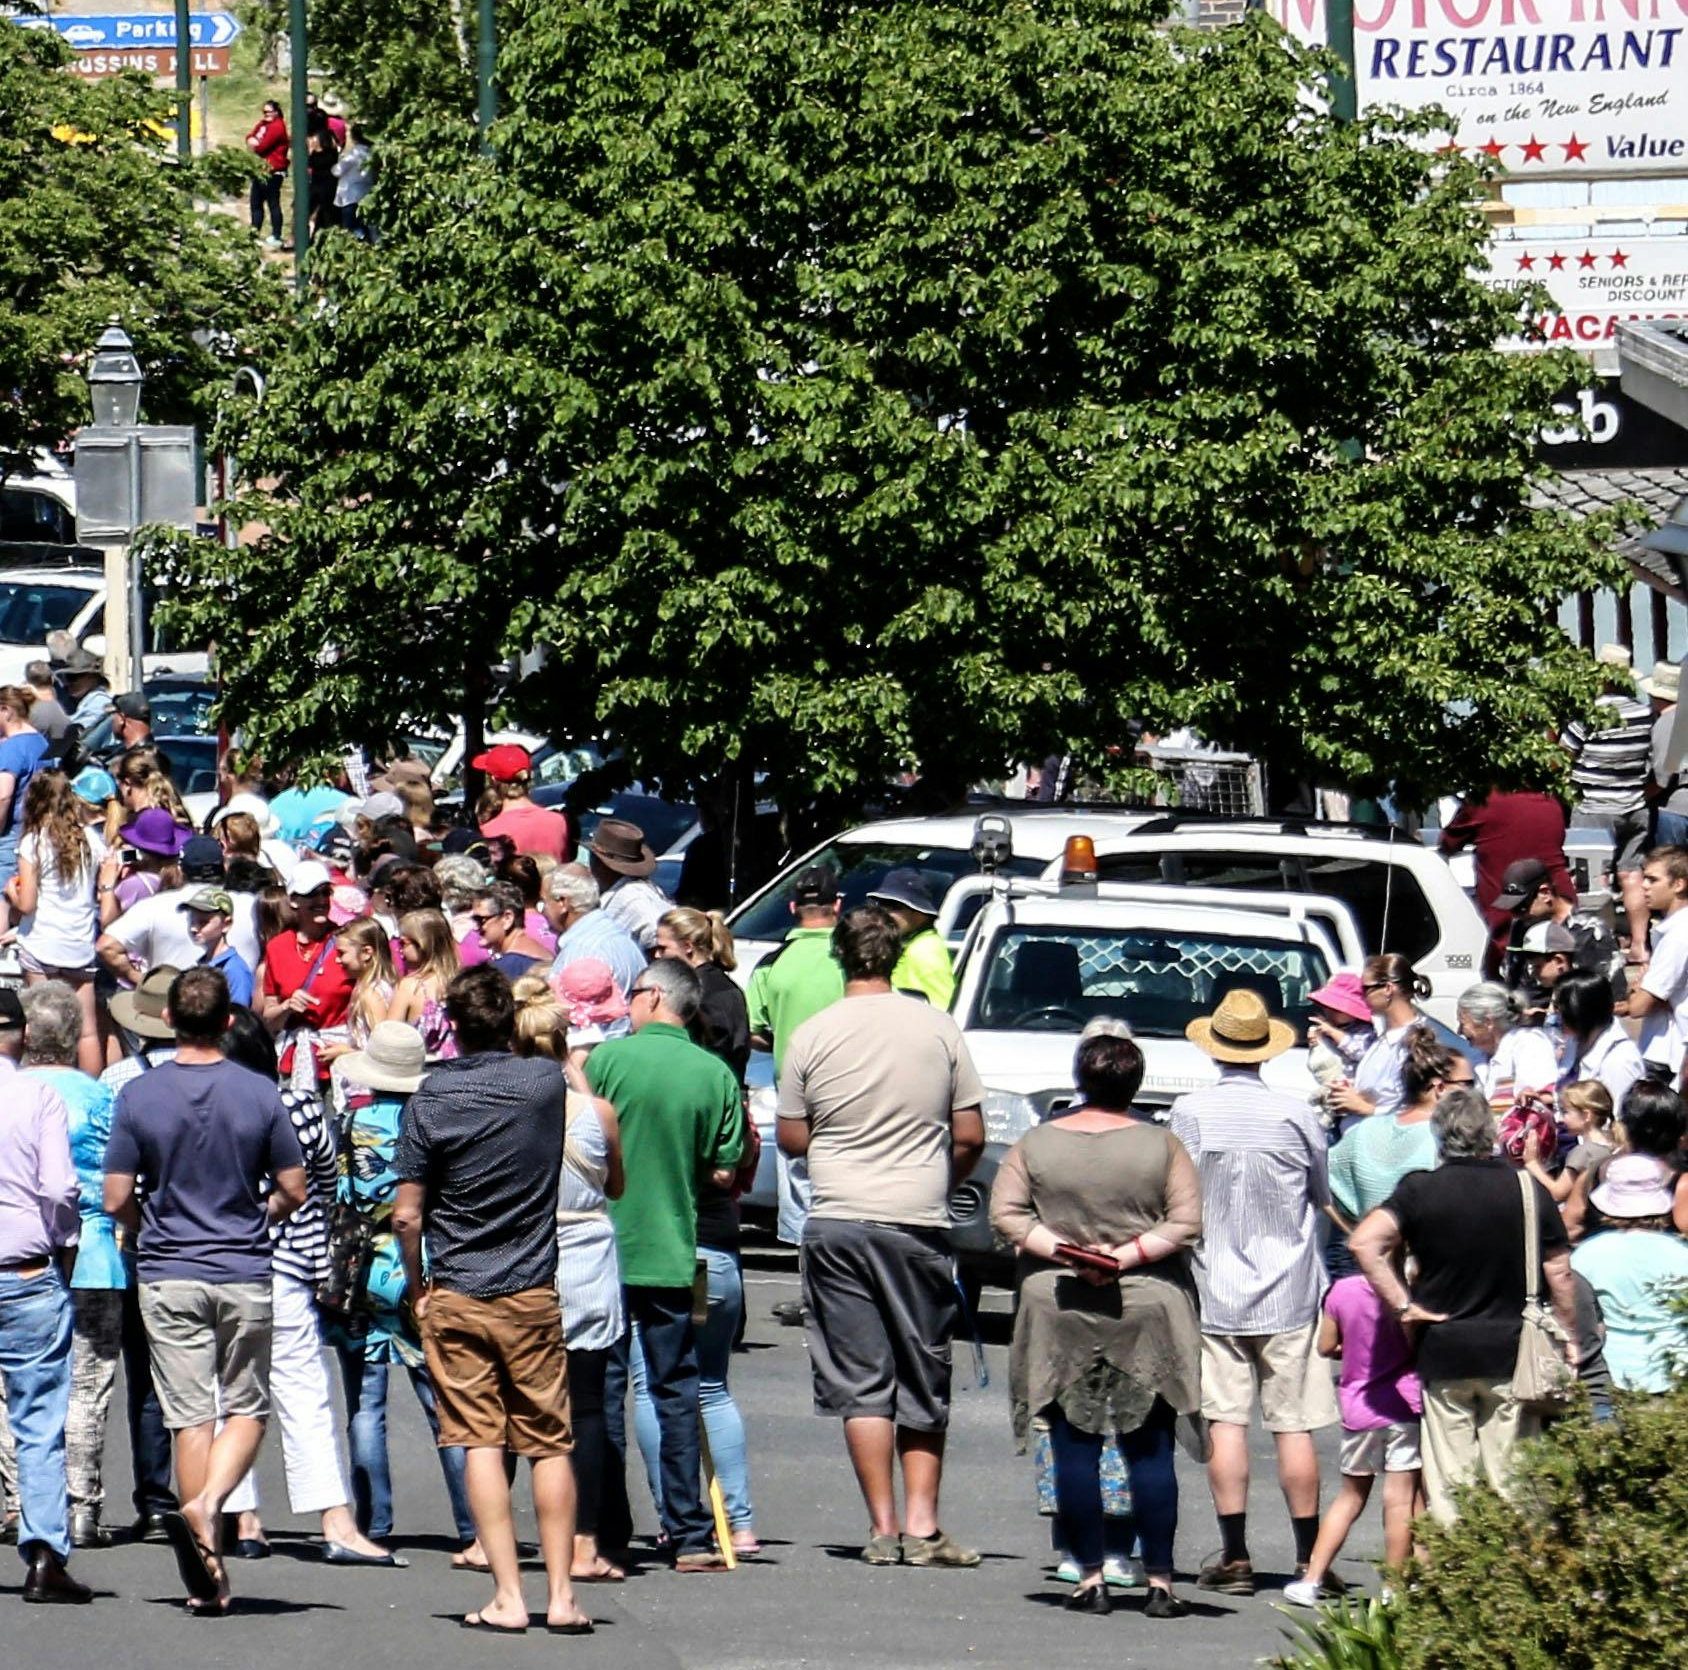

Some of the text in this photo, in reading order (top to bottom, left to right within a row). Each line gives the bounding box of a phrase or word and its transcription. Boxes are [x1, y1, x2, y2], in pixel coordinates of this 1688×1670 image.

[116, 20, 203, 42] Parkig
[1370, 27, 1684, 80] RESTAURANT
[1446, 81, 1545, 98] Circa 1864
[1476, 112, 1498, 125] on
[1504, 104, 1532, 122] the
[1537, 98, 1580, 117] New
[1587, 89, 1671, 117] England
[1606, 132, 1686, 159] Value
[1578, 274, 1644, 289] SENIORS
[1608, 288, 1686, 303] DISCOUNT
